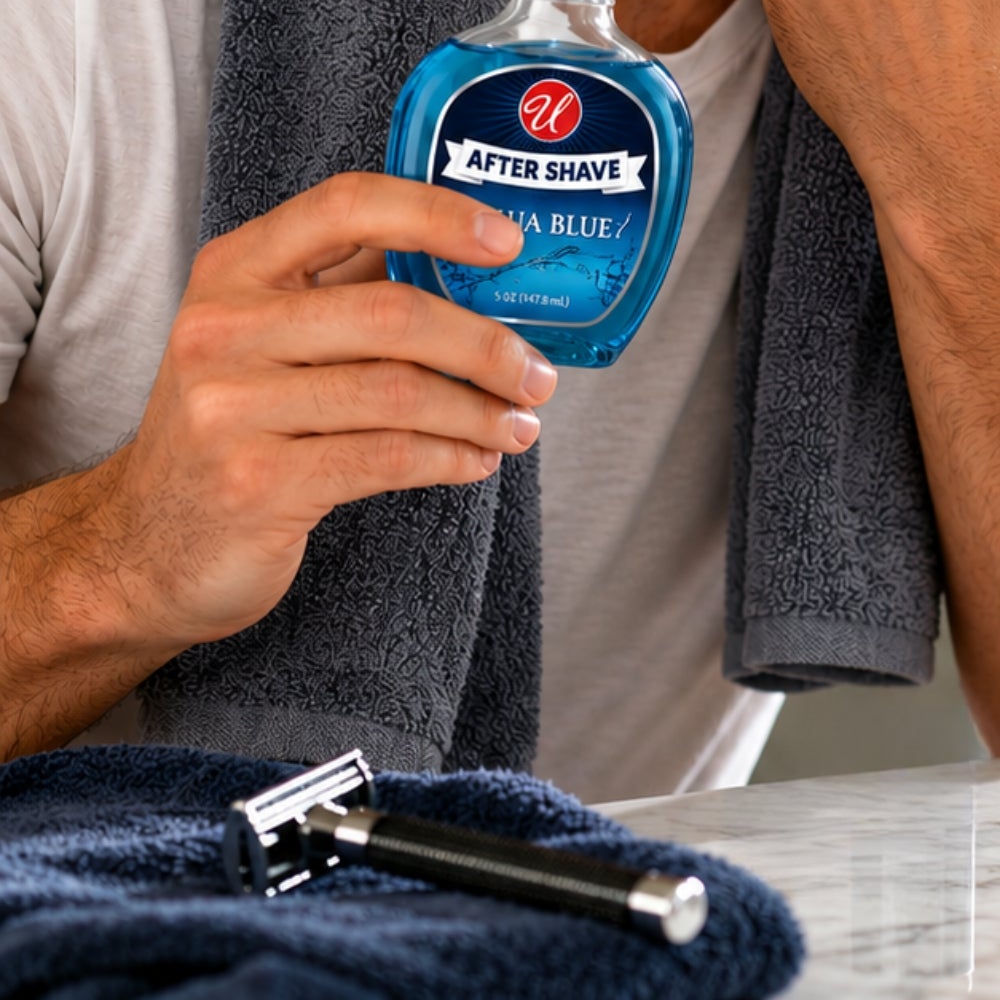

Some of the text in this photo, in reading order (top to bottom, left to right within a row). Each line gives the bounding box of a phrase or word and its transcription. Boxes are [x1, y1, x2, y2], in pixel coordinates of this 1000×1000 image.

[524, 92, 573, 133] U
[466, 149, 621, 182] AFTER SHAVE
[498, 210, 613, 239] UA BLUE
[494, 290, 501, 302] 5
